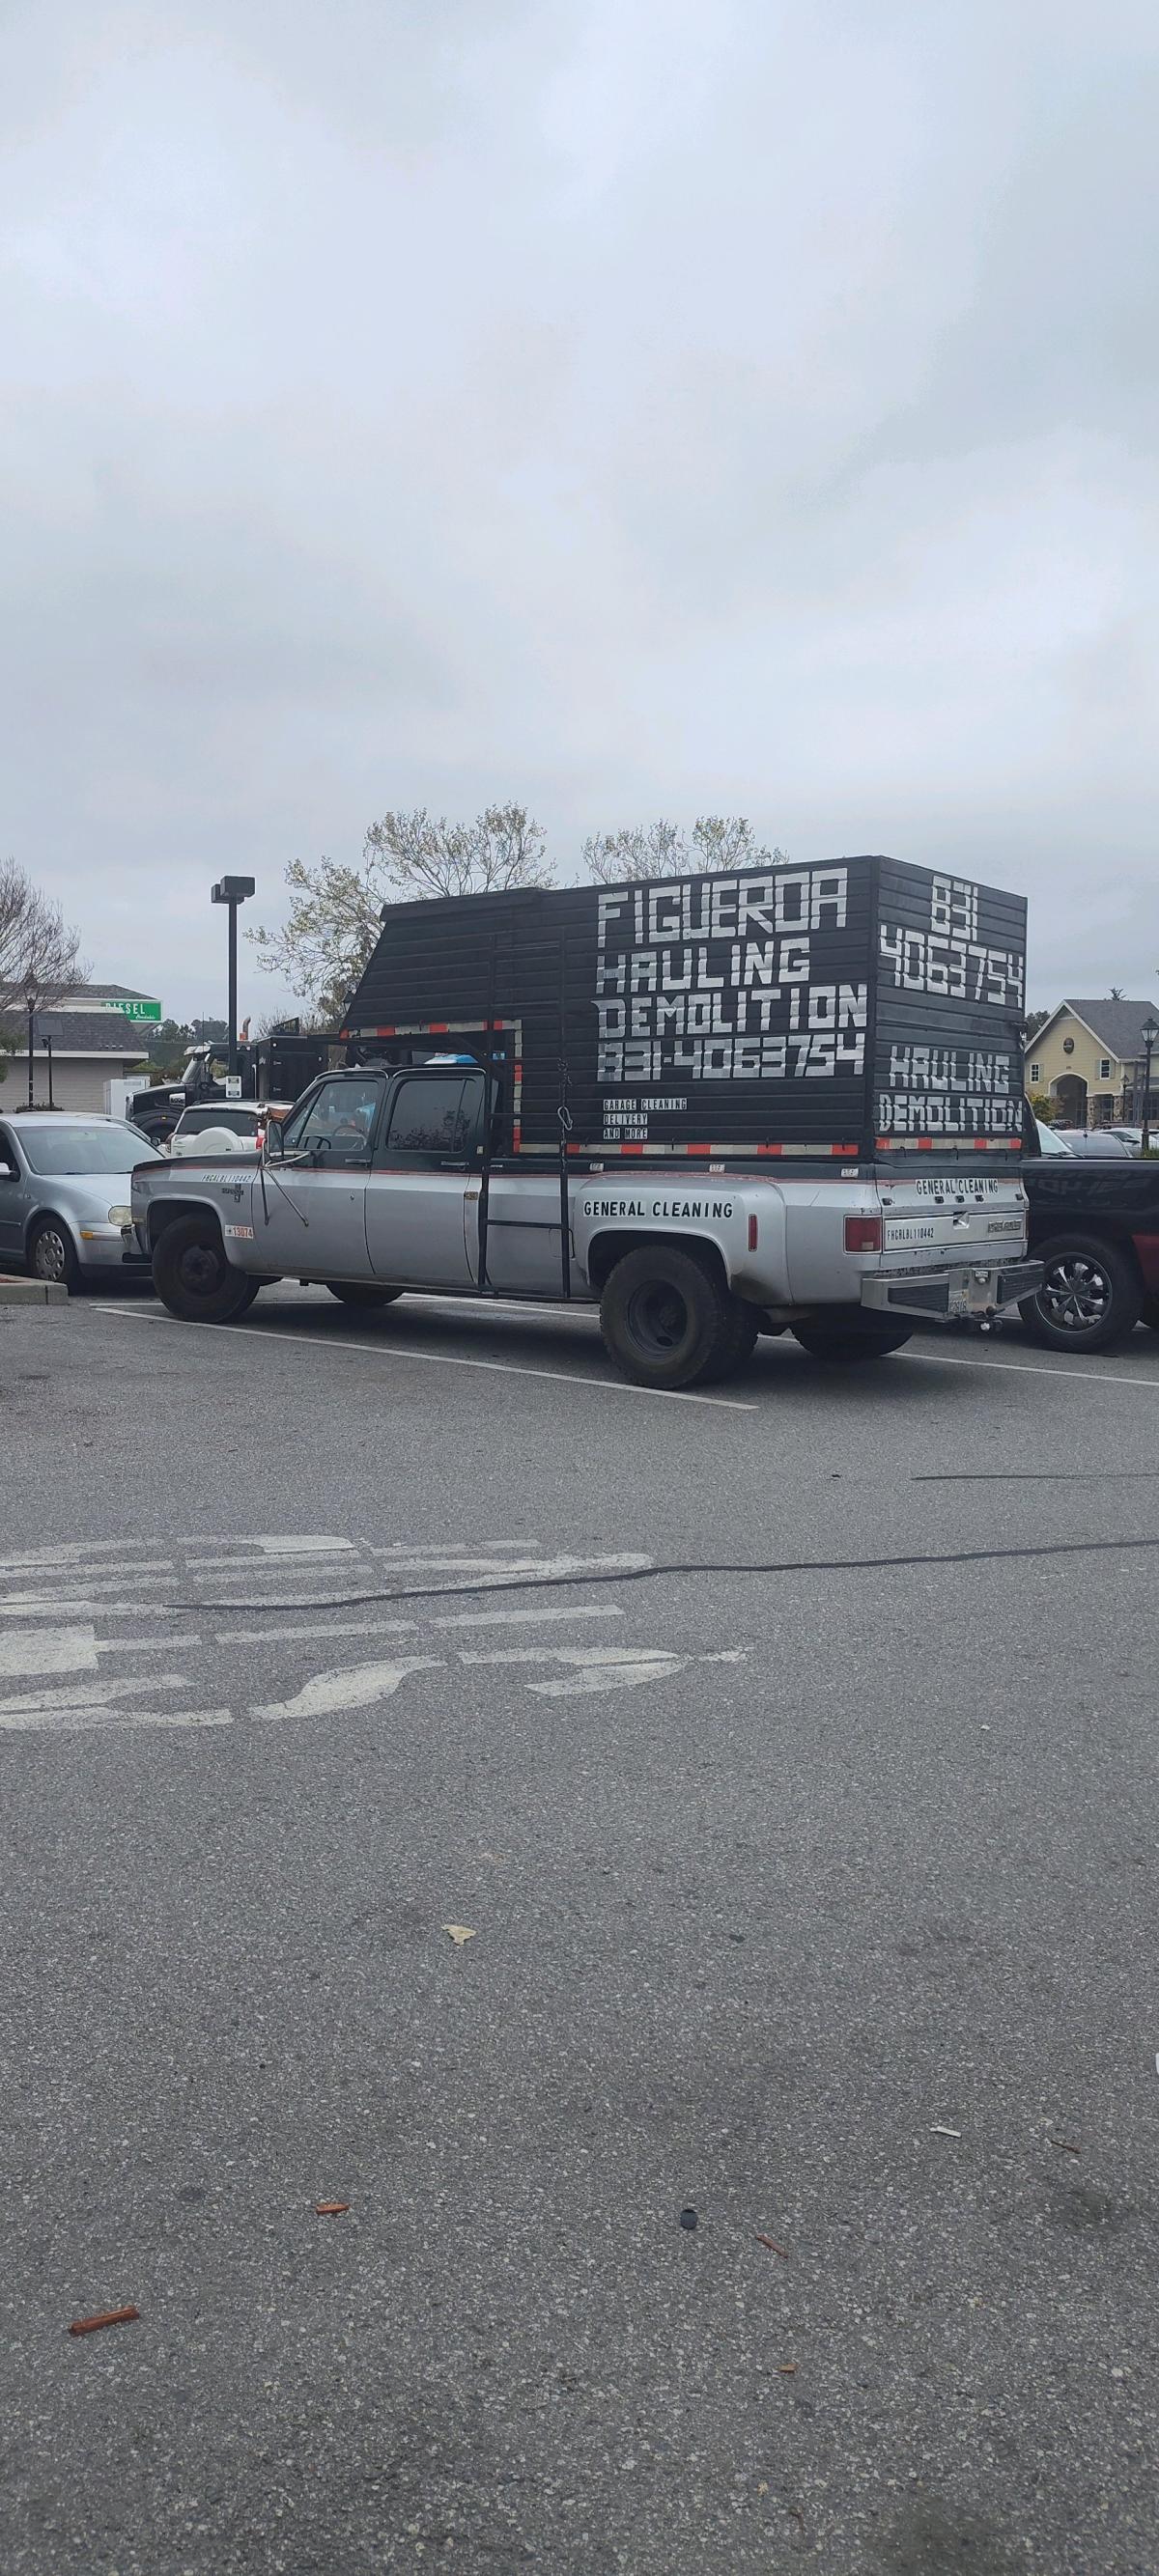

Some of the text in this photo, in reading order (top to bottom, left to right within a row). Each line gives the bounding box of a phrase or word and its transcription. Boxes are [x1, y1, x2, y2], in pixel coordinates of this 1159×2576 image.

[597, 867, 848, 948] FIGUEROA
[930, 876, 978, 941] 831
[596, 938, 810, 994] HAULING
[879, 924, 1024, 1008] 4063754
[590, 983, 868, 1039] DEMOLITION
[596, 1033, 865, 1082] 831-4063754
[890, 1045, 1010, 1094] HAULING
[604, 1098, 687, 1110] GARAGE CLEANING
[604, 1113, 647, 1125] DELIVERY
[879, 1093, 1023, 1133] DEMOLITION
[604, 1128, 647, 1139] AND MORE
[583, 1201, 733, 1218] GENERAL CLEANING
[917, 1179, 999, 1195] GENERAL CLEANING
